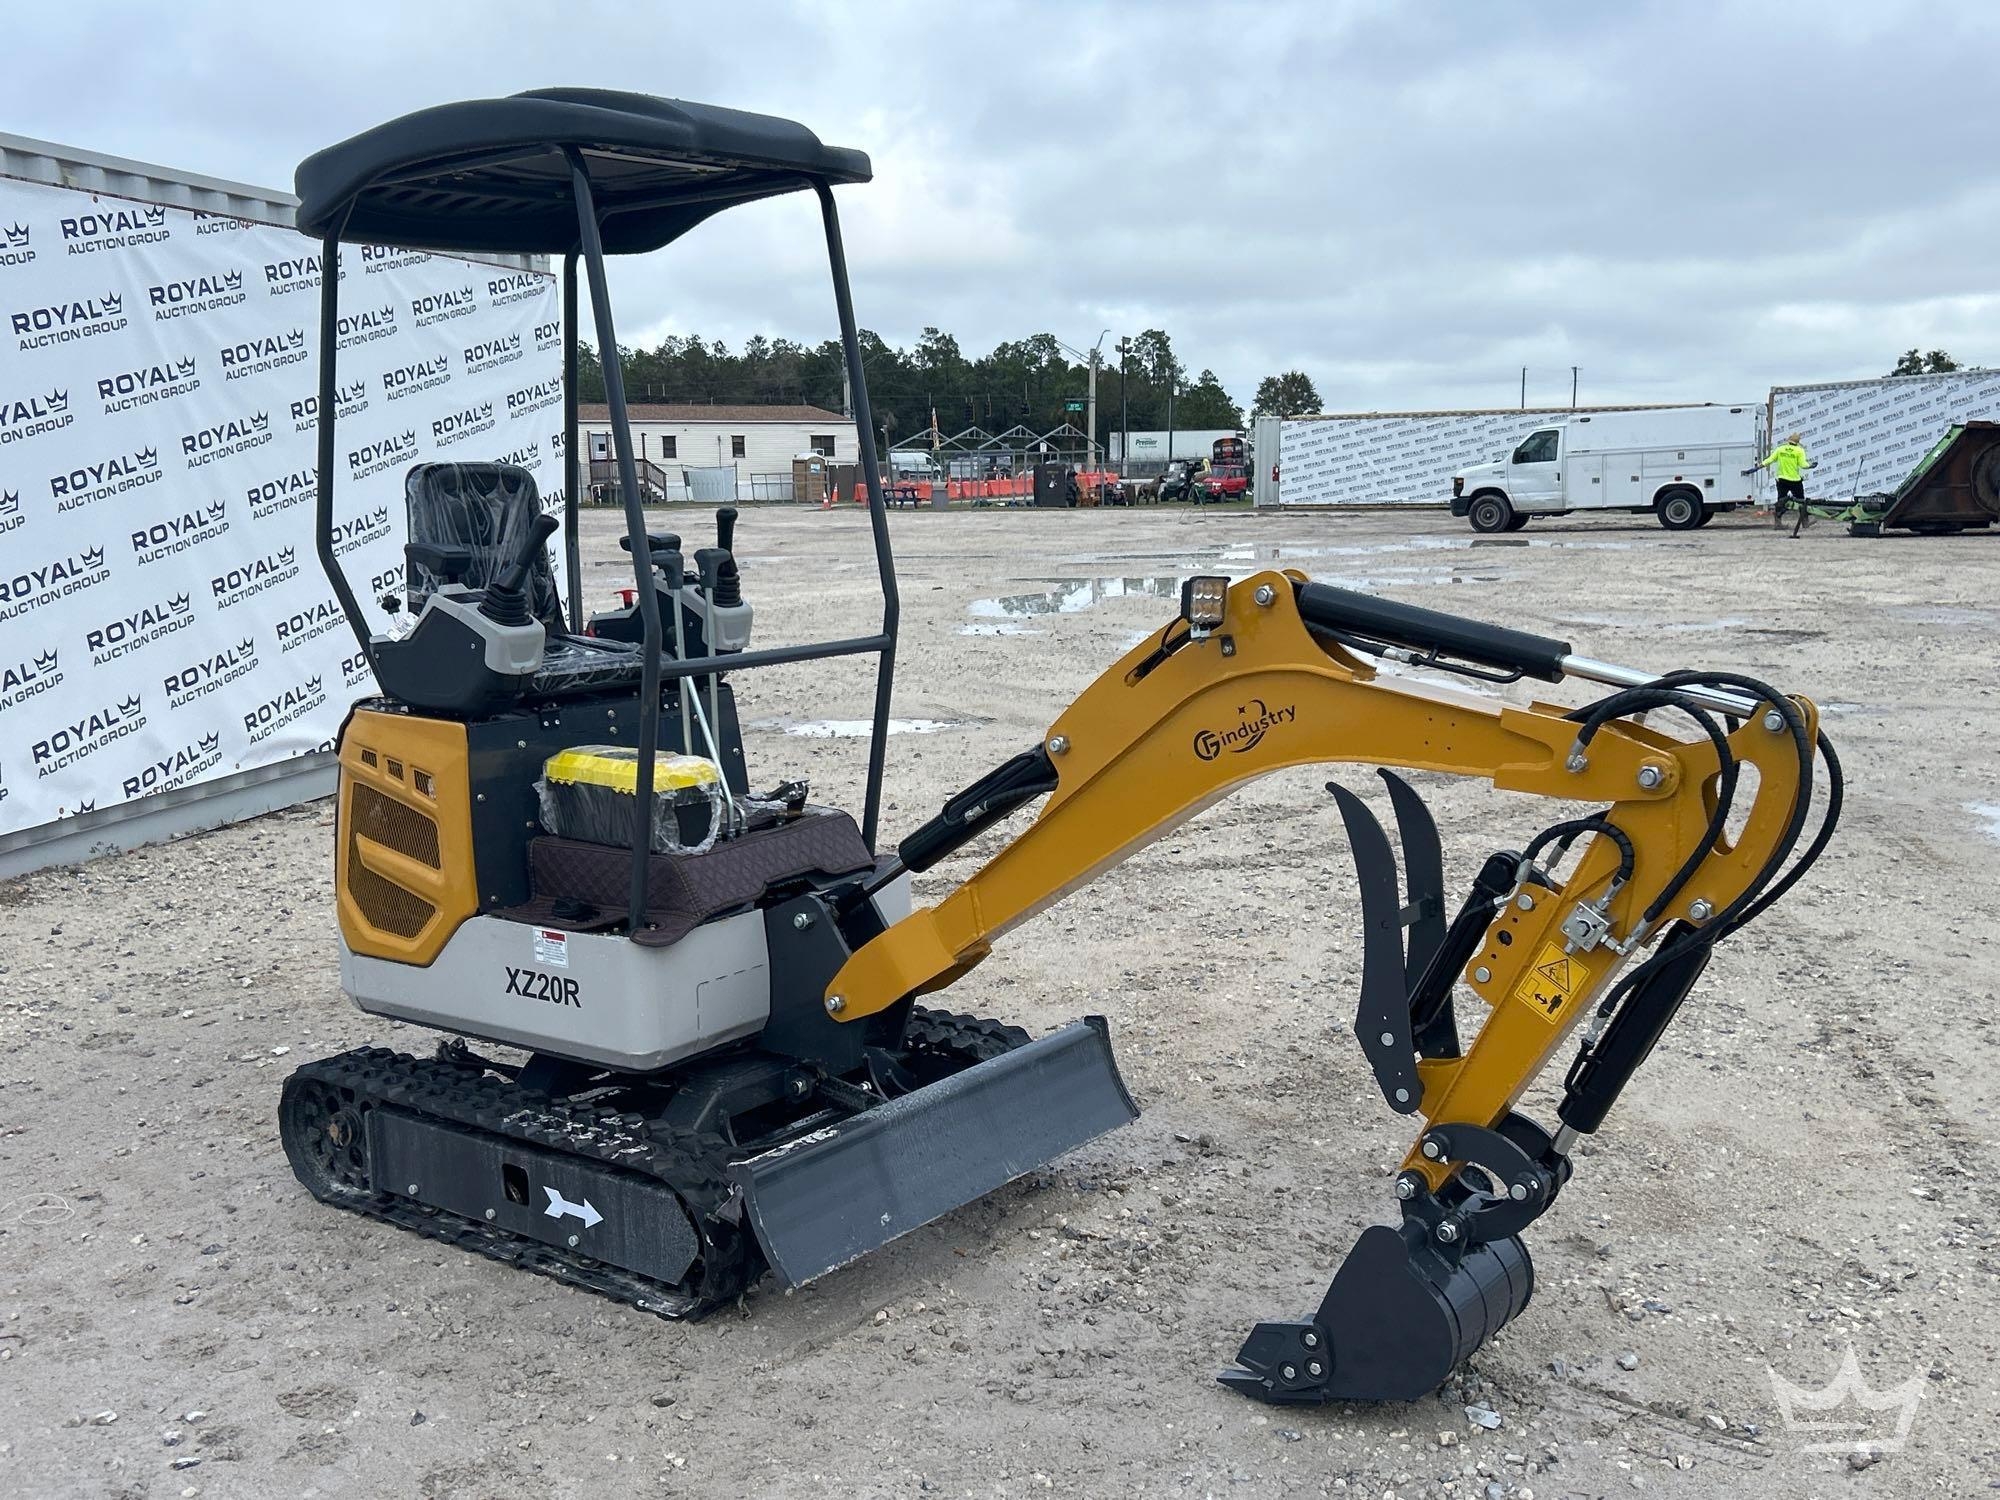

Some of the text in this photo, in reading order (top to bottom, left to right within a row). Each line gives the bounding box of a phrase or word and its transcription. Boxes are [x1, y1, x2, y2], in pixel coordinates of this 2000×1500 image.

[61, 211, 145, 238] ROYAL
[69, 231, 169, 254] AUCTION GROUP
[366, 260, 401, 273] AUCTION
[149, 276, 224, 305] ROYAL
[271, 279, 312, 295] AUCTION
[488, 271, 532, 295] ROYAL
[492, 286, 544, 306] AUCTION GROUP
[11, 300, 101, 334] ROYAL
[156, 293, 245, 320] AUCTION GROUP
[412, 291, 461, 315] ROYAL
[416, 305, 475, 327] AUCTION GROUP
[20, 319, 126, 350] AUCTION GROUP
[334, 311, 380, 334] OYAL
[221, 336, 288, 366] ROYAL
[334, 326, 396, 350] UCTION GROUP
[464, 338, 509, 363] ROYAL
[226, 351, 306, 380] AUCTION GROUP
[383, 361, 435, 388] ROYAL
[468, 351, 522, 374] AUCTION GROUP
[98, 364, 178, 398] ROYAL
[388, 374, 449, 400] AUCTION GROUP
[507, 383, 549, 408] ROYAL
[105, 380, 199, 413] AUCTION GROUP
[291, 388, 351, 419] ROAL
[339, 401, 367, 417] GROUP
[511, 394, 561, 418] AUCTION GROUP
[26, 415, 72, 435] GROUP
[182, 419, 251, 454] ROYAL
[432, 408, 480, 436] ROYAL
[437, 420, 494, 447] AUCTION GROUP
[188, 433, 271, 468] AUCTION GROUP
[349, 437, 402, 468] ROYAL
[354, 449, 417, 480] AUCTION GROUP
[51, 456, 136, 497] ROYAL
[58, 470, 161, 512] AUCTION GROUP
[248, 471, 313, 506] ROYAL
[254, 496, 296, 519] AUCTION
[132, 510, 208, 550] ROYAL
[139, 522, 228, 565] AUCTION GROUP
[362, 525, 390, 543] GROUP
[63, 570, 109, 594] GROUP
[212, 556, 278, 596] ROYAL
[218, 567, 298, 609] AUCTION GROUP
[87, 605, 168, 651] ROYAL
[276, 600, 338, 639] ROYAL
[94, 615, 194, 666] AUCTION GROUP
[283, 625, 323, 652] AUCTION
[164, 650, 238, 695] ROYAL
[171, 658, 257, 709] AUCTION GROUP
[15, 673, 62, 702] GROUP
[244, 687, 306, 731] ROYAL
[250, 694, 325, 744] AUCTION GROUP
[32, 709, 119, 763] ROYAL
[39, 717, 146, 778] AUCTION GROUP
[123, 746, 199, 798] ROYAL
[186, 752, 221, 779] GROUP
[505, 966, 582, 1008] XZ20R
